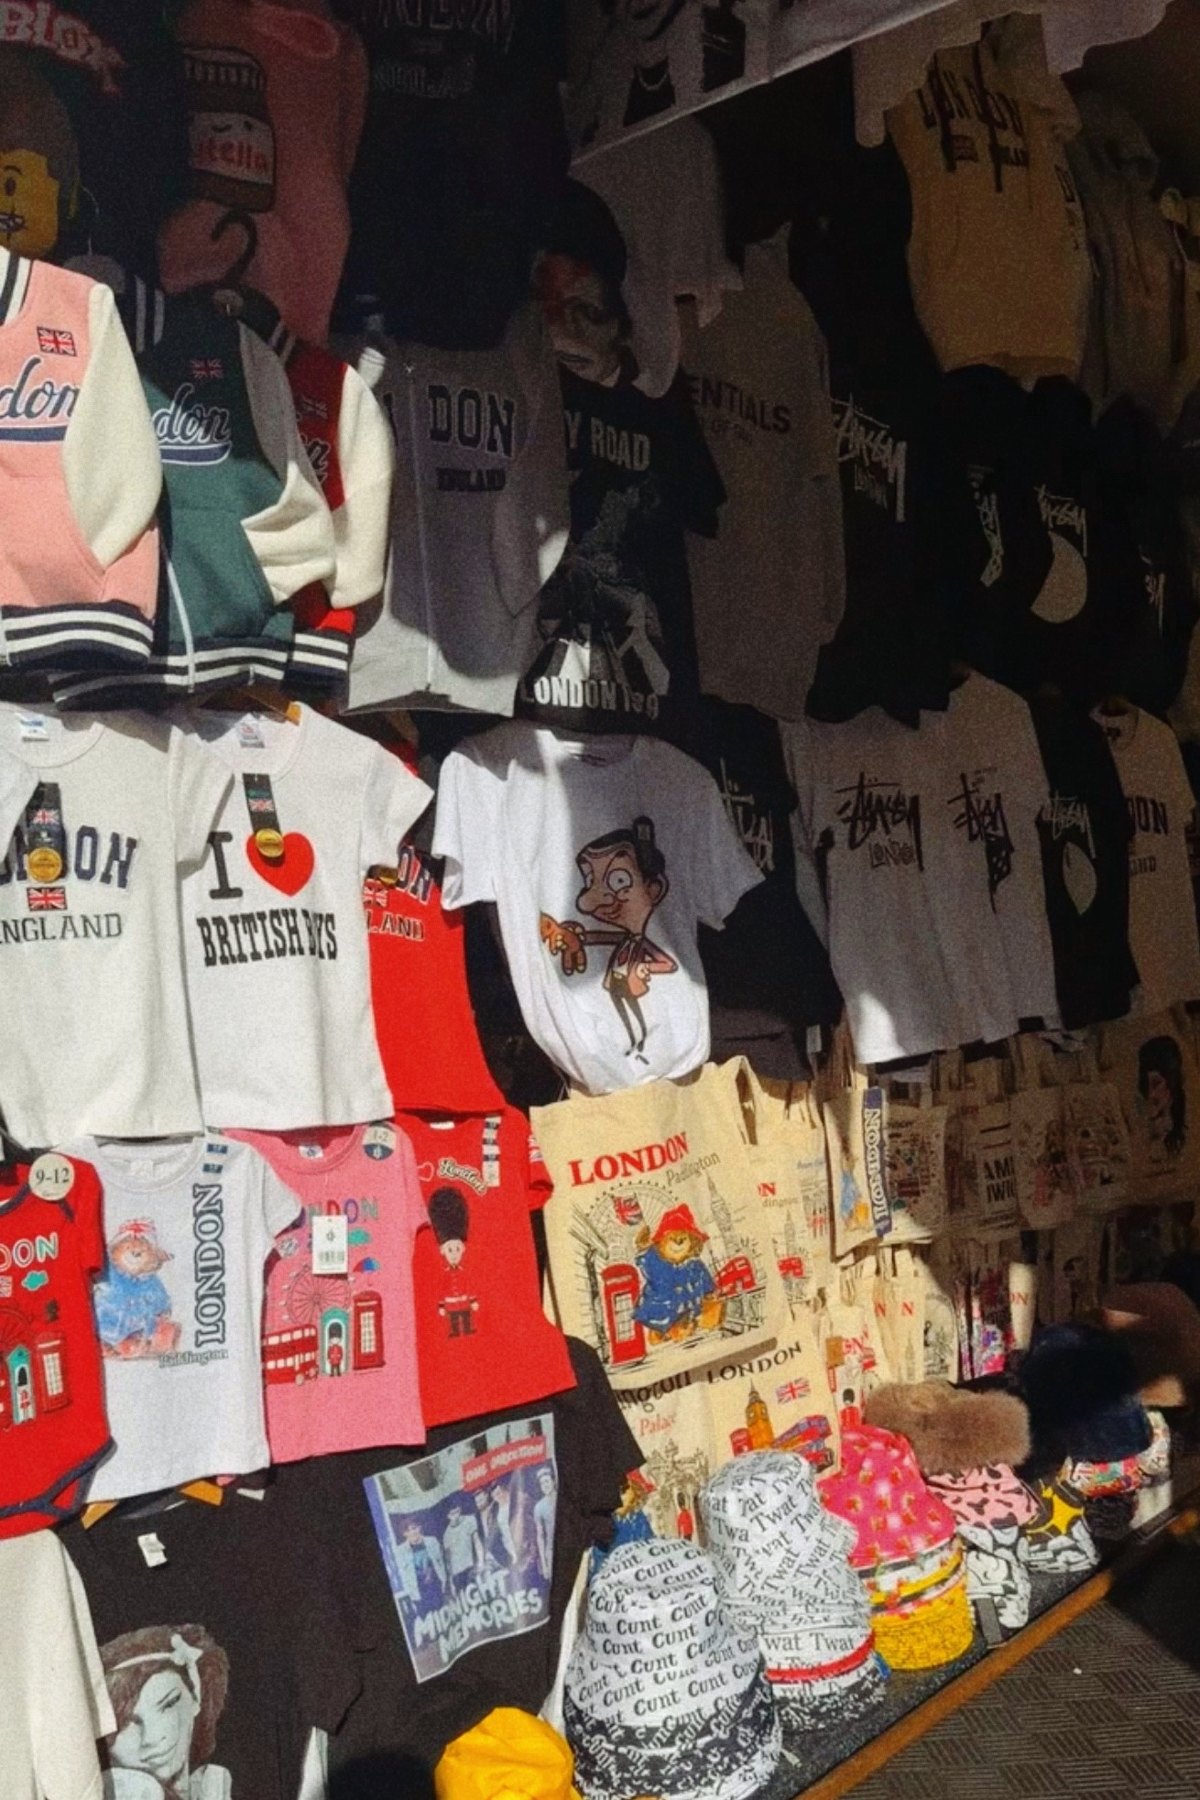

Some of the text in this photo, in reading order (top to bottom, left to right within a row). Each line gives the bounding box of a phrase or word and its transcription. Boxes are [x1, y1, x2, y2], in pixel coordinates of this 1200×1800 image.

[427, 385, 515, 458] DON
[591, 416, 650, 471] ROAD
[521, 676, 617, 711] LONDON
[207, 831, 243, 899] I
[0, 912, 122, 945] NGLAND
[196, 908, 304, 967] BRITISH
[36, 1167, 70, 1185] 9-12
[567, 1131, 690, 1187] LONDON
[193, 1183, 226, 1348] LONDON
[706, 1341, 802, 1384] LONDON
[749, 1494, 798, 1532] Twat
[634, 1558, 678, 1582] Cunt
[663, 1563, 706, 1585] Cunt
[761, 1547, 800, 1592] Twat
[793, 1536, 830, 1578] Twat
[414, 1567, 510, 1648] MIDNIGHT
[438, 1587, 543, 1662] MEMORIES
[617, 1615, 662, 1636] Cunt
[671, 1595, 708, 1622] Cunt
[602, 1623, 699, 1655] Cunt Cunt
[631, 1653, 678, 1674] Cunt
[579, 1673, 609, 1703] Cunt
[603, 1677, 645, 1708] Cunt
[688, 1671, 729, 1698] Cunt
[633, 1688, 681, 1717] Cunt
